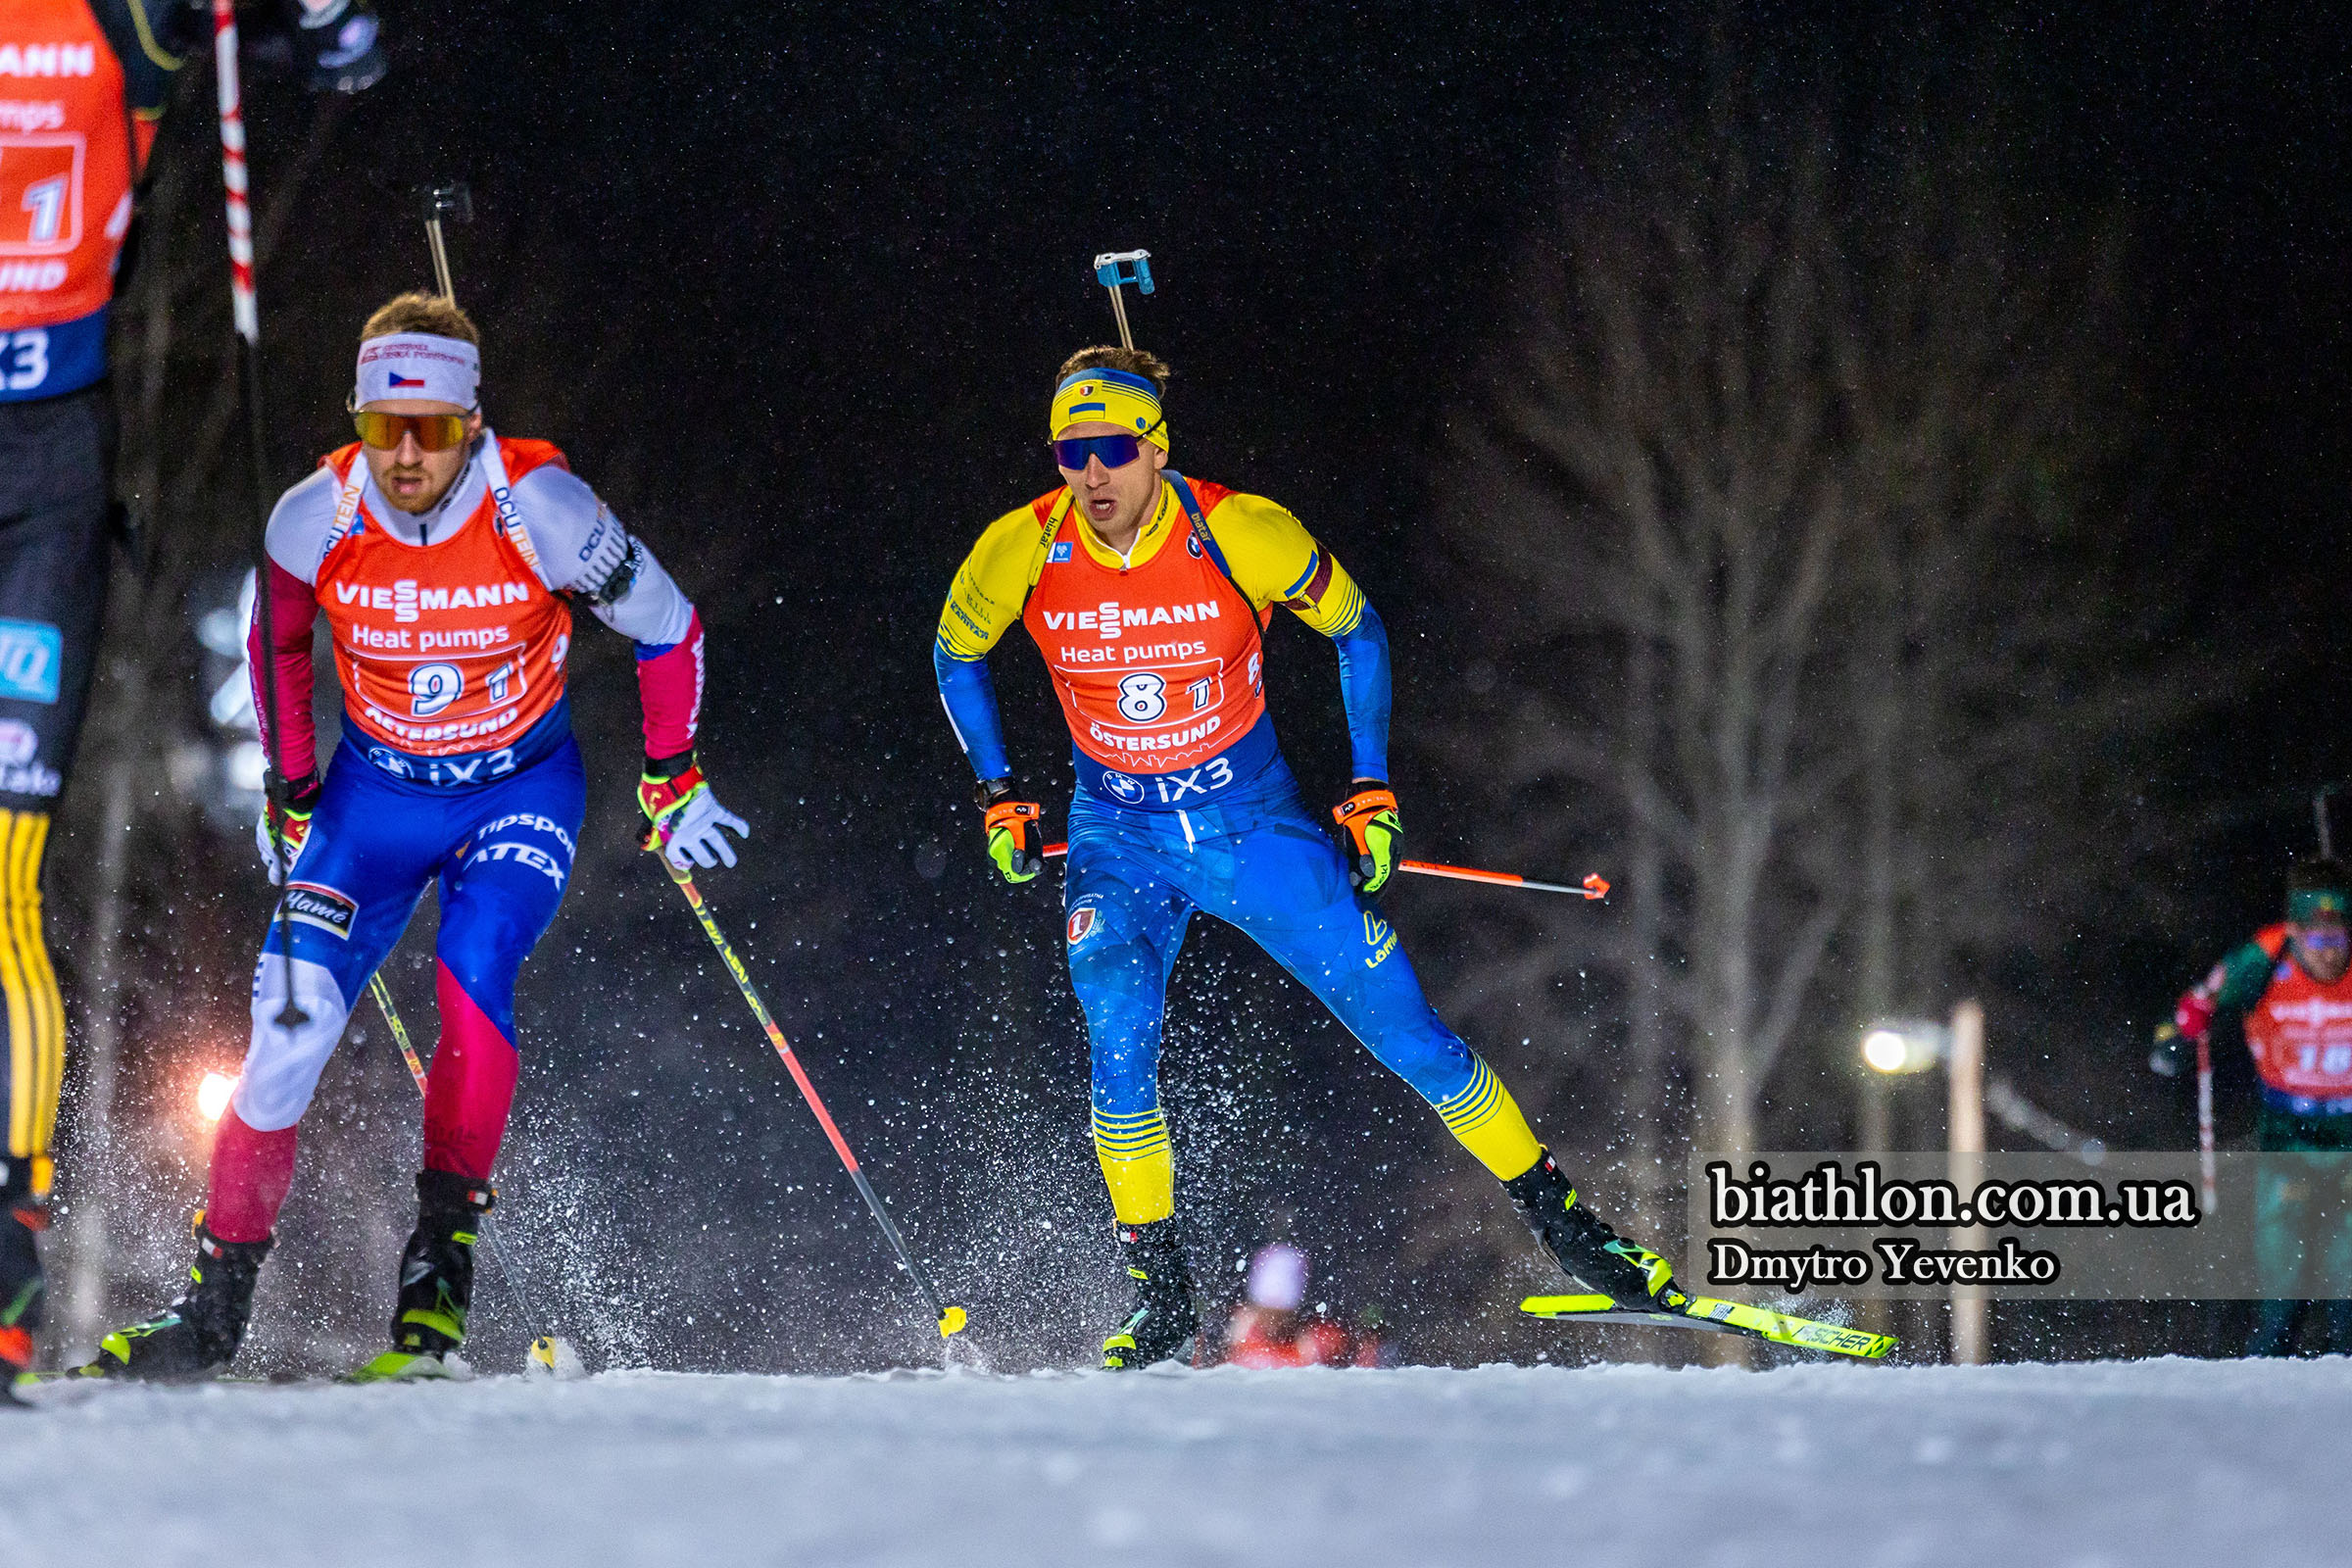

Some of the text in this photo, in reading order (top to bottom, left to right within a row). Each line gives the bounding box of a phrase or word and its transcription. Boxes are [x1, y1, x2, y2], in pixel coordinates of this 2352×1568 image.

[22, 172, 66, 246] 1
[493, 486, 539, 567] OCUTEIN
[335, 579, 530, 623] VIESSMANN
[1043, 600, 1221, 640] VIESSMANN
[352, 624, 510, 653] Heat pumps
[1060, 641, 1206, 663] Heat pumps
[408, 662, 465, 717] 9
[1116, 671, 1167, 723] 8
[1090, 715, 1221, 752] ÖSTERSUND
[1154, 757, 1234, 804] iX3
[286, 891, 349, 923] Hamé
[1791, 1325, 1872, 1351] SCHER
